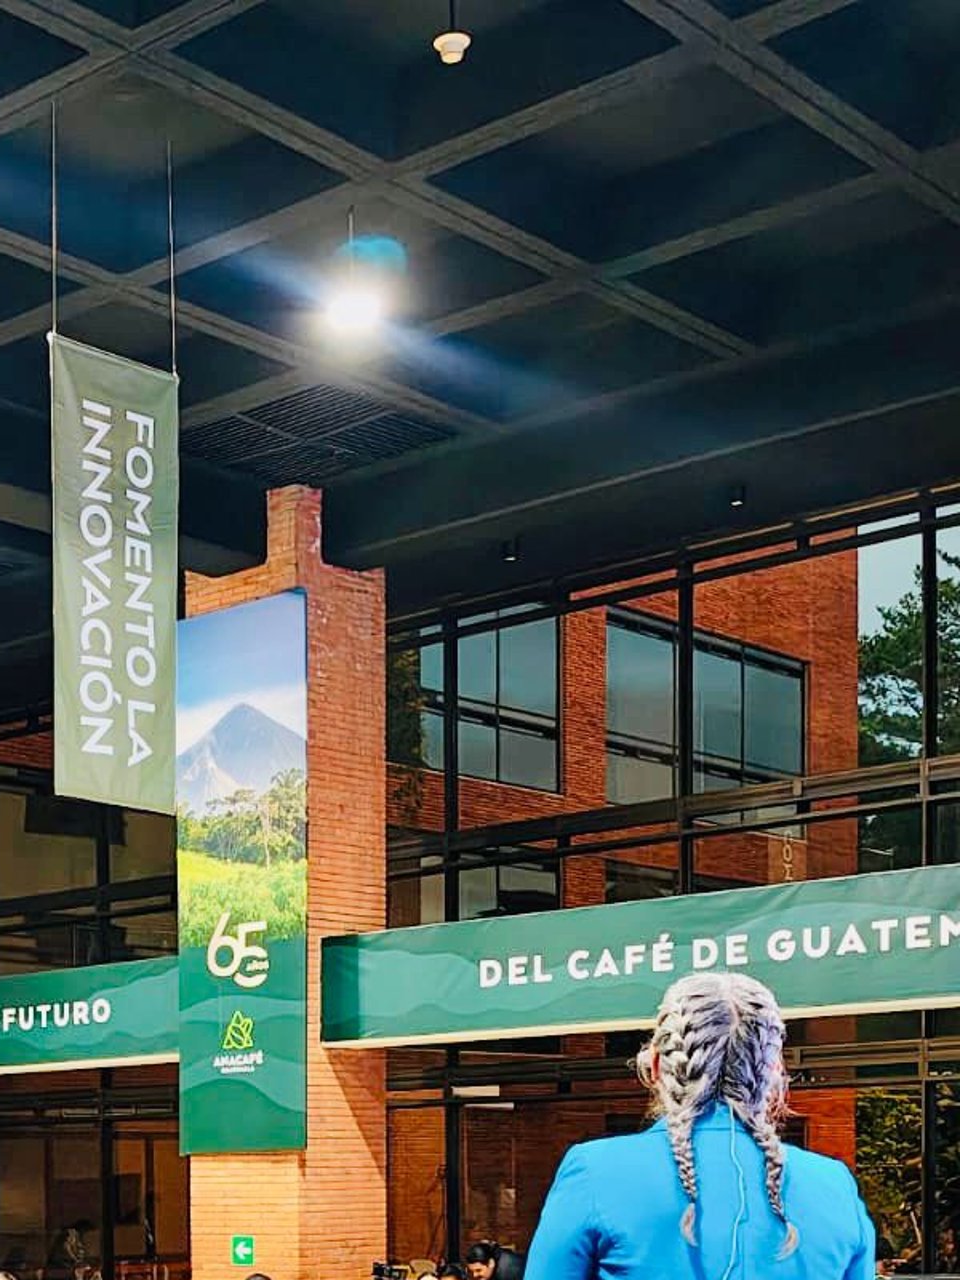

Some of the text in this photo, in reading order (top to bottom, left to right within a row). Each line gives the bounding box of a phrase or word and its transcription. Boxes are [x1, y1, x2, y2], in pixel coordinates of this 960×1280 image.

[79, 398, 123, 757] INNOVACIÓN
[125, 410, 157, 767] FOMENTO LA
[207, 907, 267, 988] 65
[478, 955, 553, 988] DEL
[567, 933, 676, 979] CAFÉ
[692, 933, 749, 969] DE
[2, 997, 112, 1032] FUTURO
